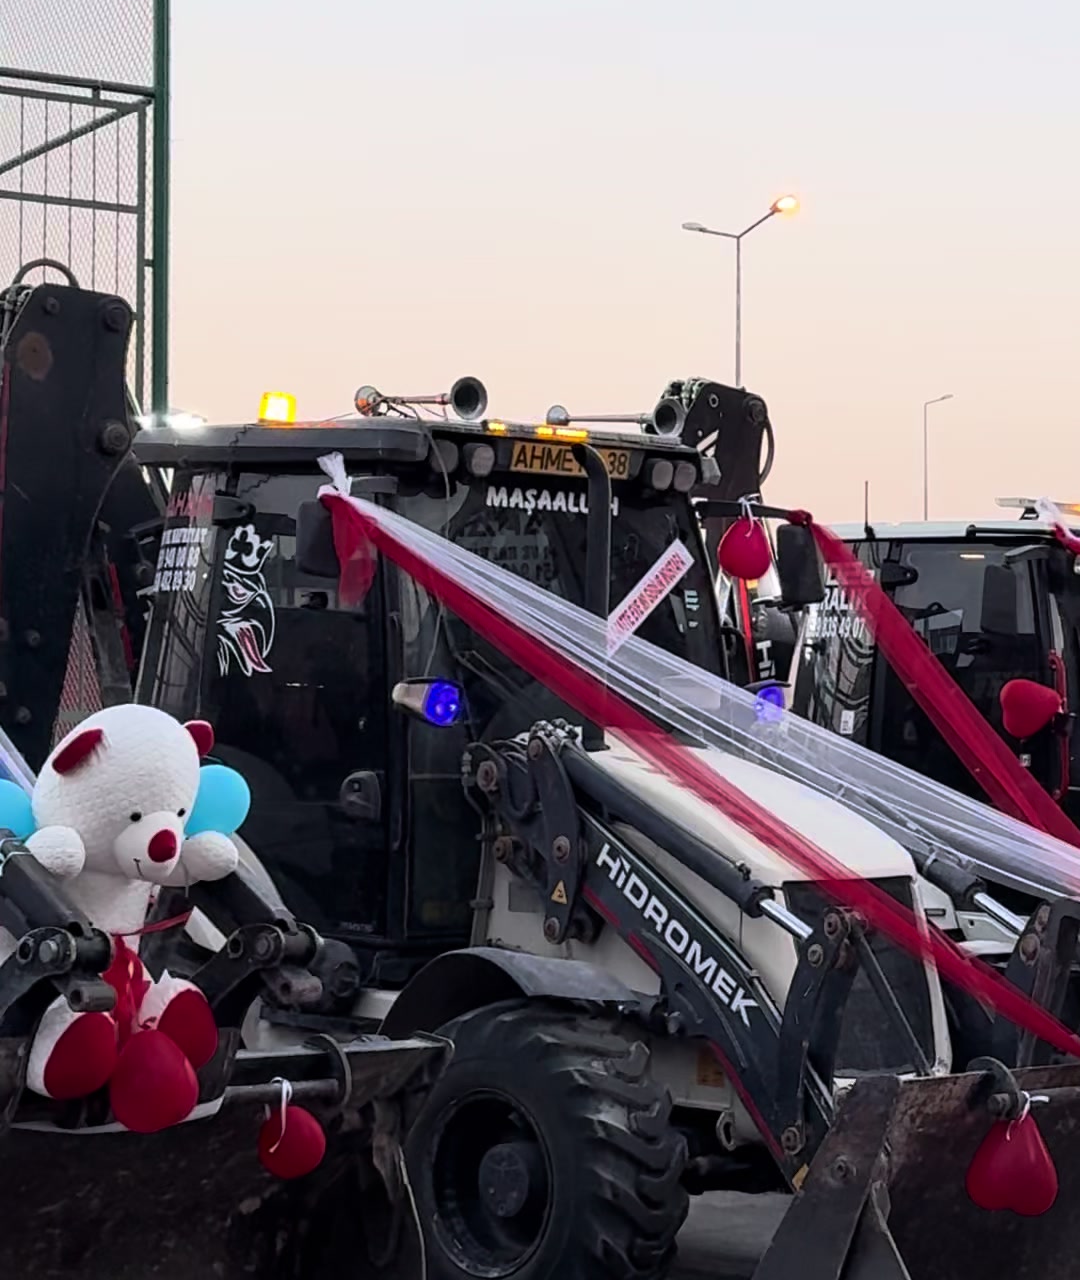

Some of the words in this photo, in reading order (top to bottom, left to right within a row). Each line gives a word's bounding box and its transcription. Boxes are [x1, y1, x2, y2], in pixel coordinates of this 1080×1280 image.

[514, 444, 582, 473] AHME
[607, 451, 628, 476] 38
[486, 486, 619, 516] MAŞAALLH
